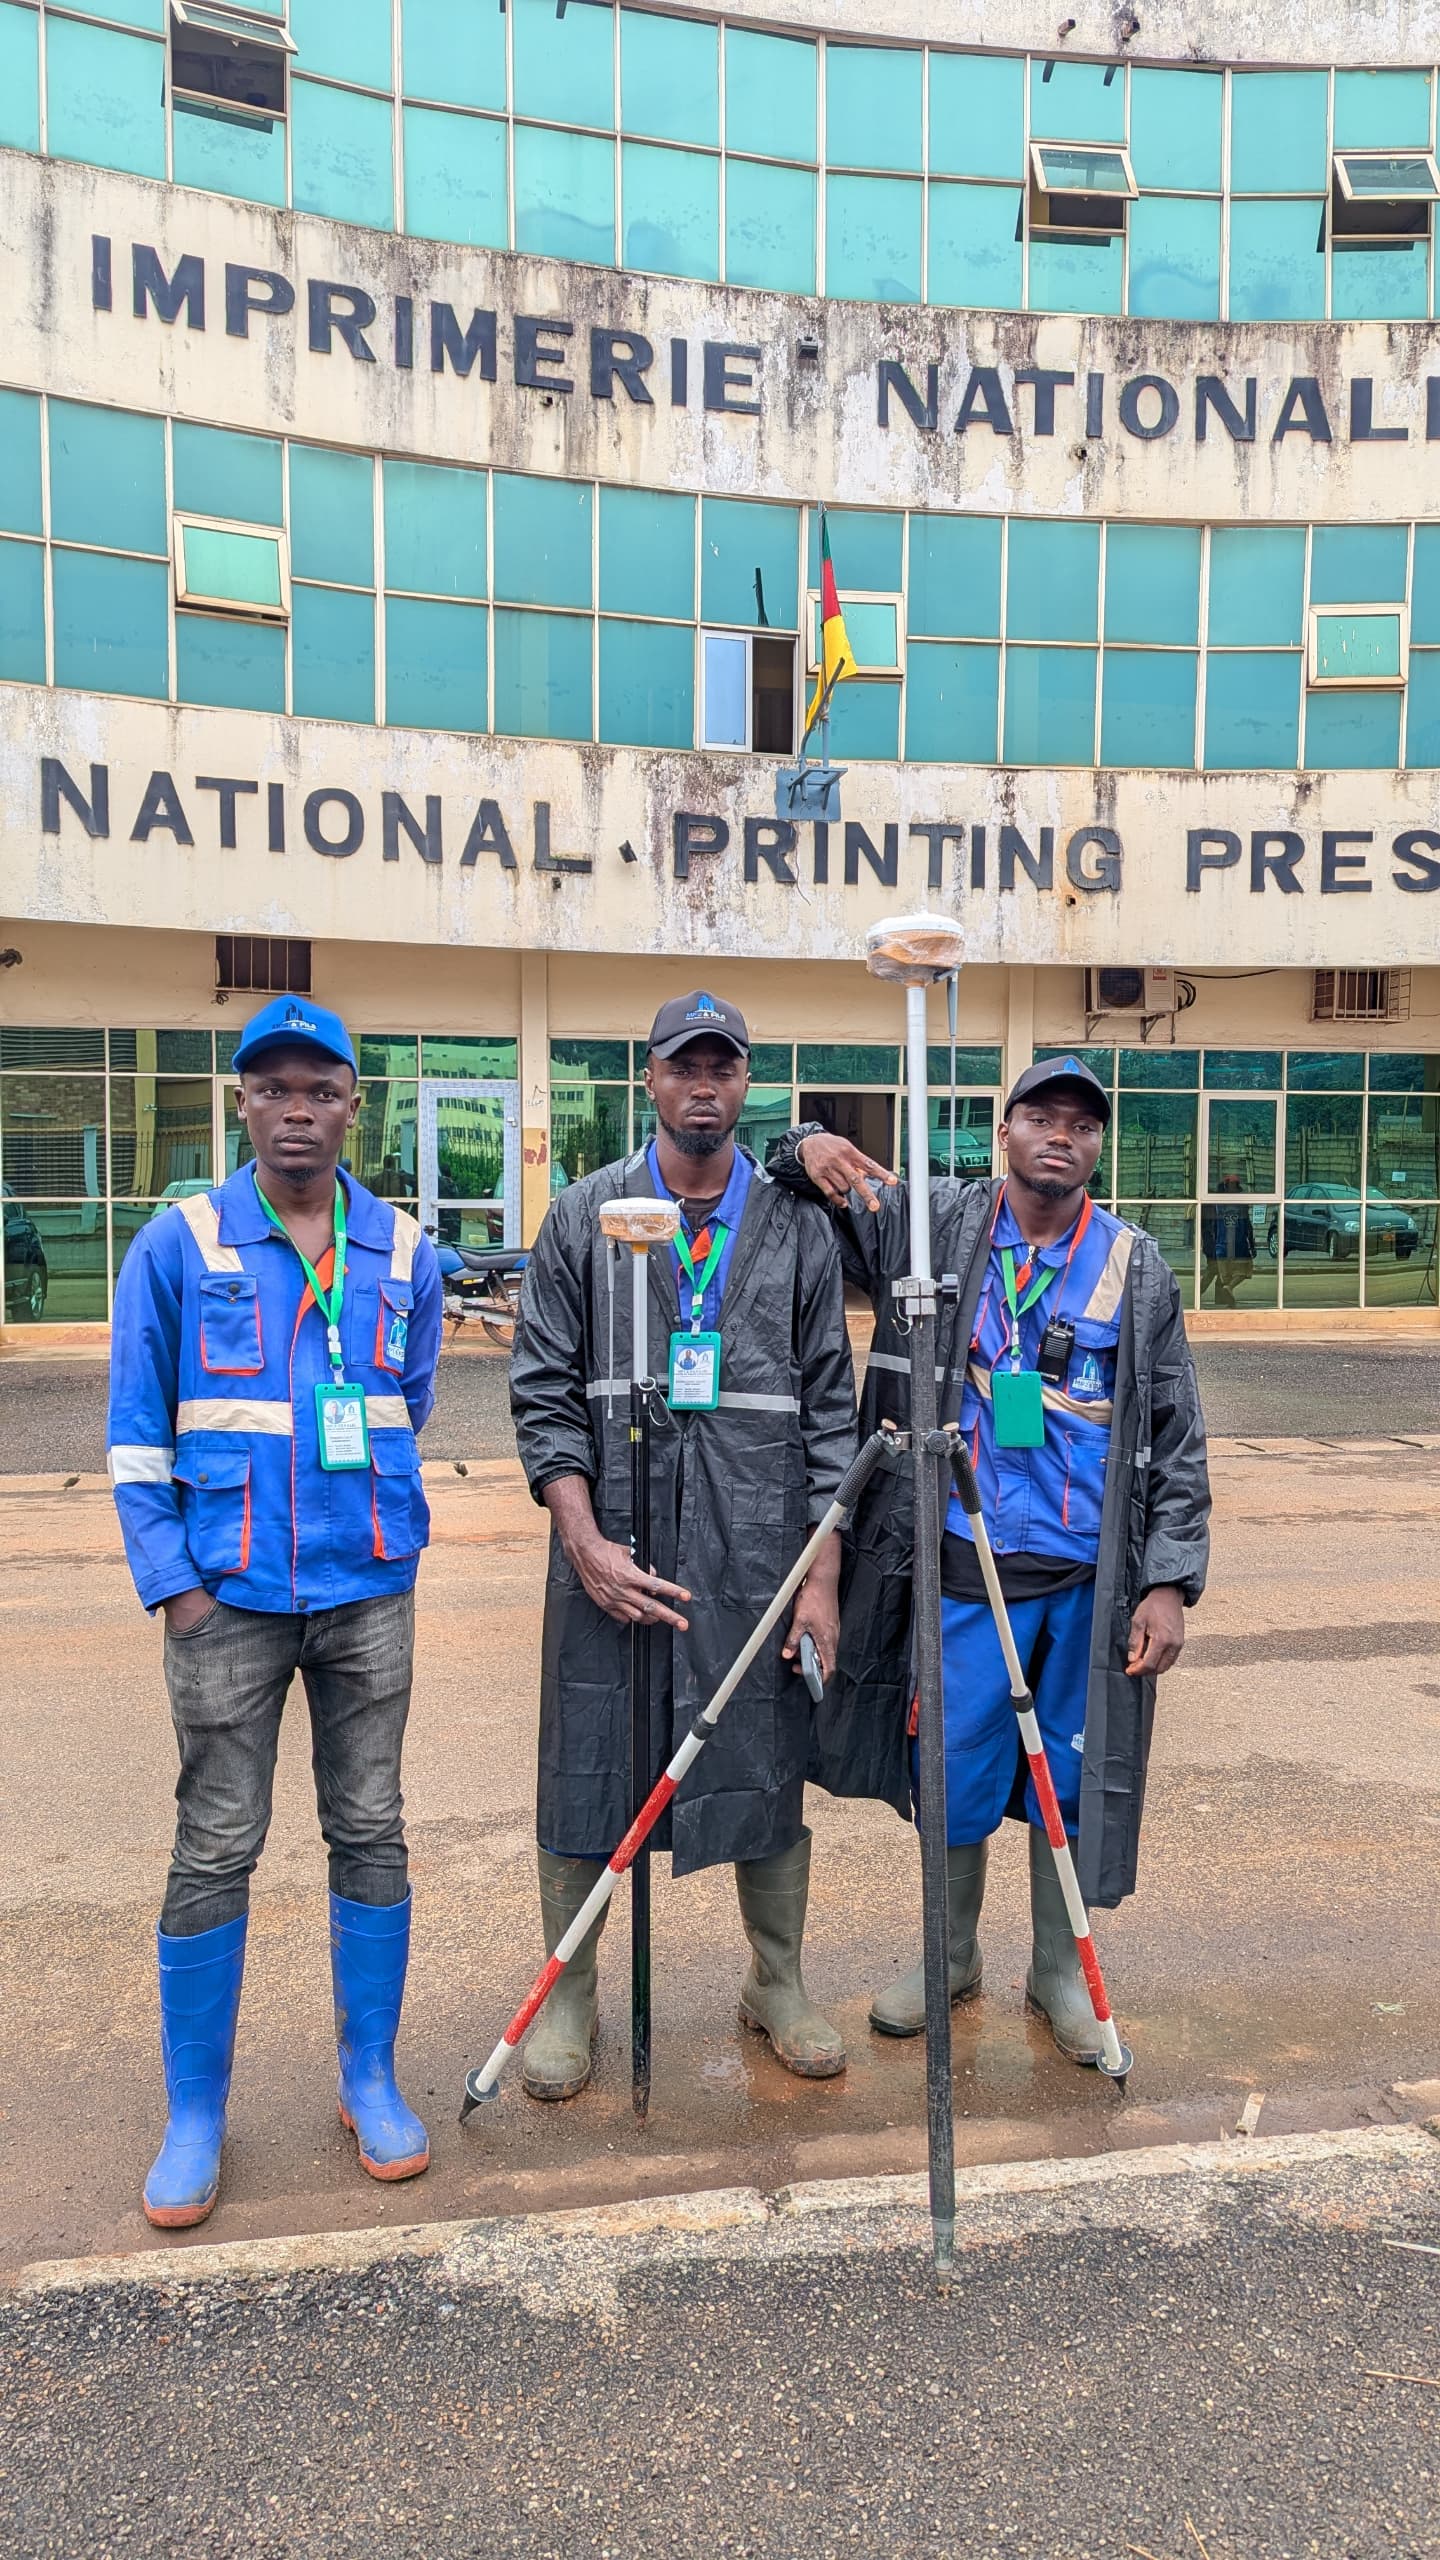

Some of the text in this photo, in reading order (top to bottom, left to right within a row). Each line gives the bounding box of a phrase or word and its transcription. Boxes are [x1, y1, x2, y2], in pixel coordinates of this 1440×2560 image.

[91, 233, 1440, 442] IMPRIMERIE NATIONAL
[41, 757, 1440, 893] NATIONAL PRINTING PRES
